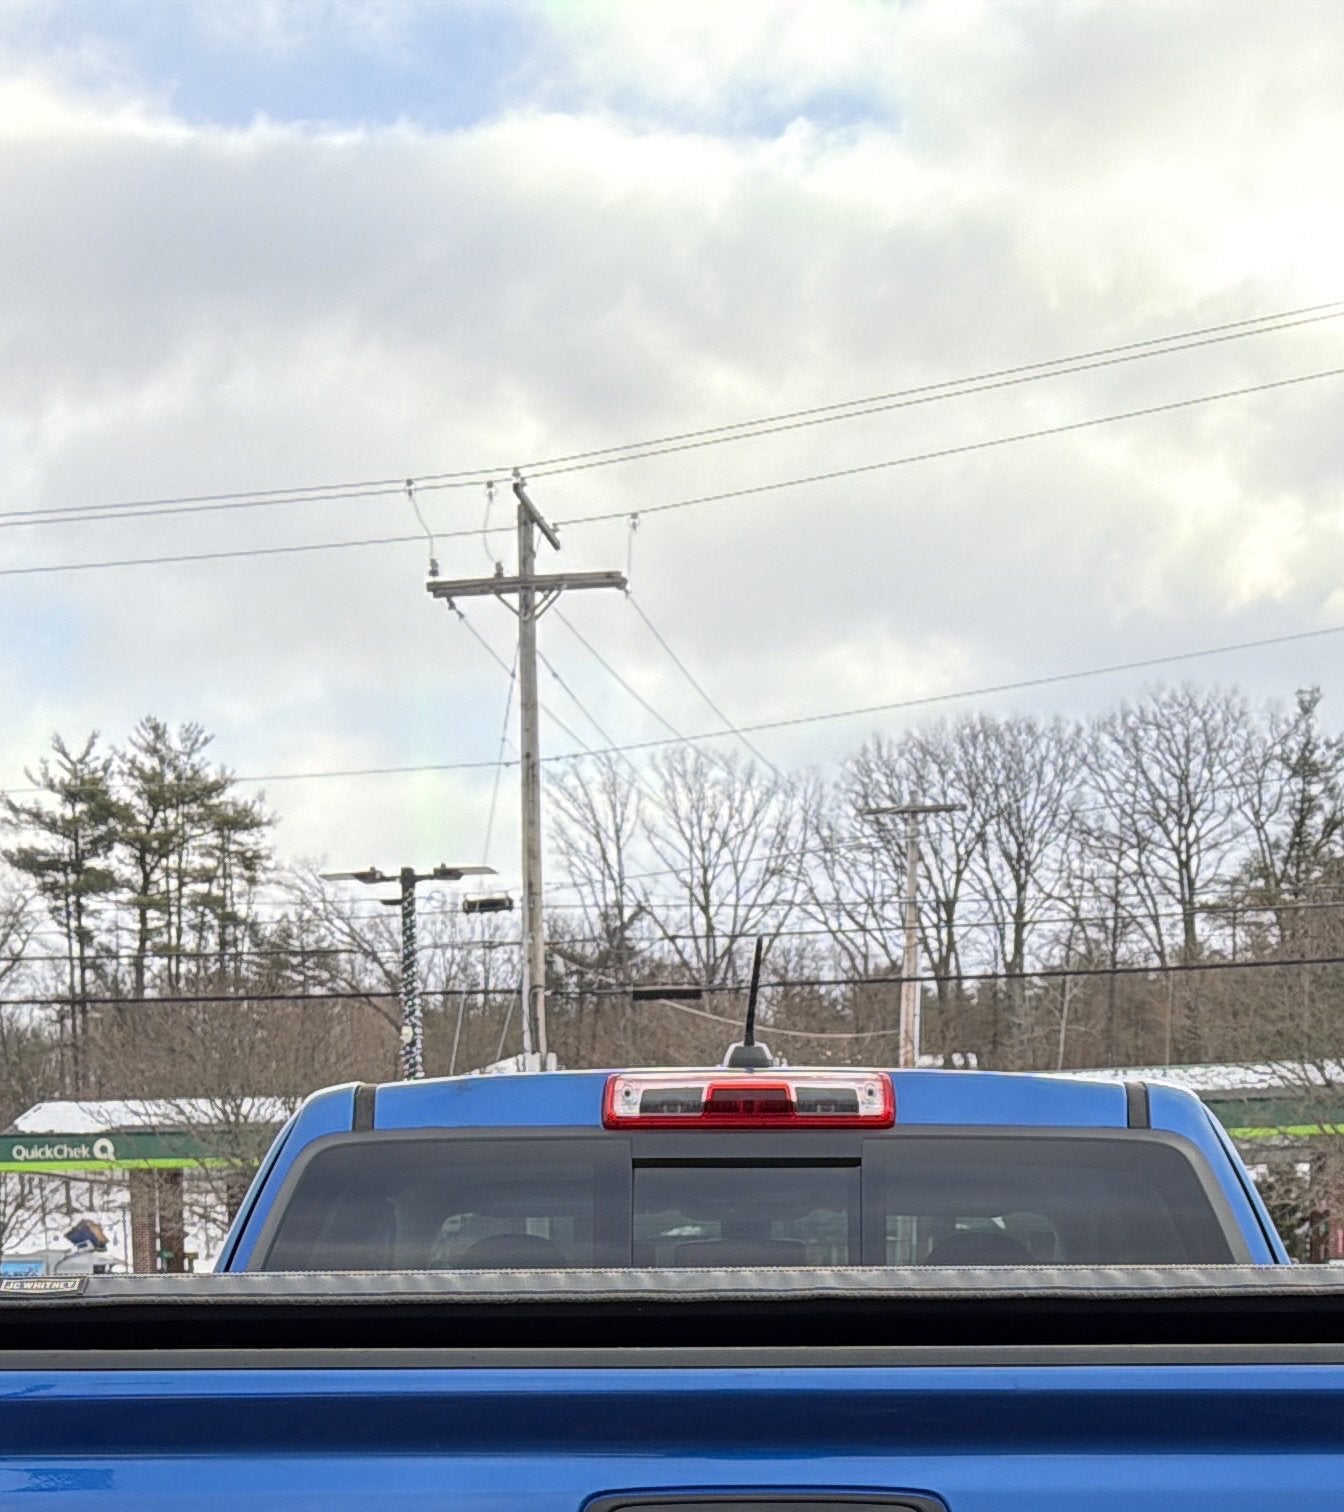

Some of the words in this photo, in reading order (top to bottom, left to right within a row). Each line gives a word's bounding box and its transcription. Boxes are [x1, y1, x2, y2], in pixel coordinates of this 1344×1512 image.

[12, 1143, 91, 1161] QuickChek
[5, 1281, 20, 1290] JC
[23, 1280, 76, 1290] WHITNEY
